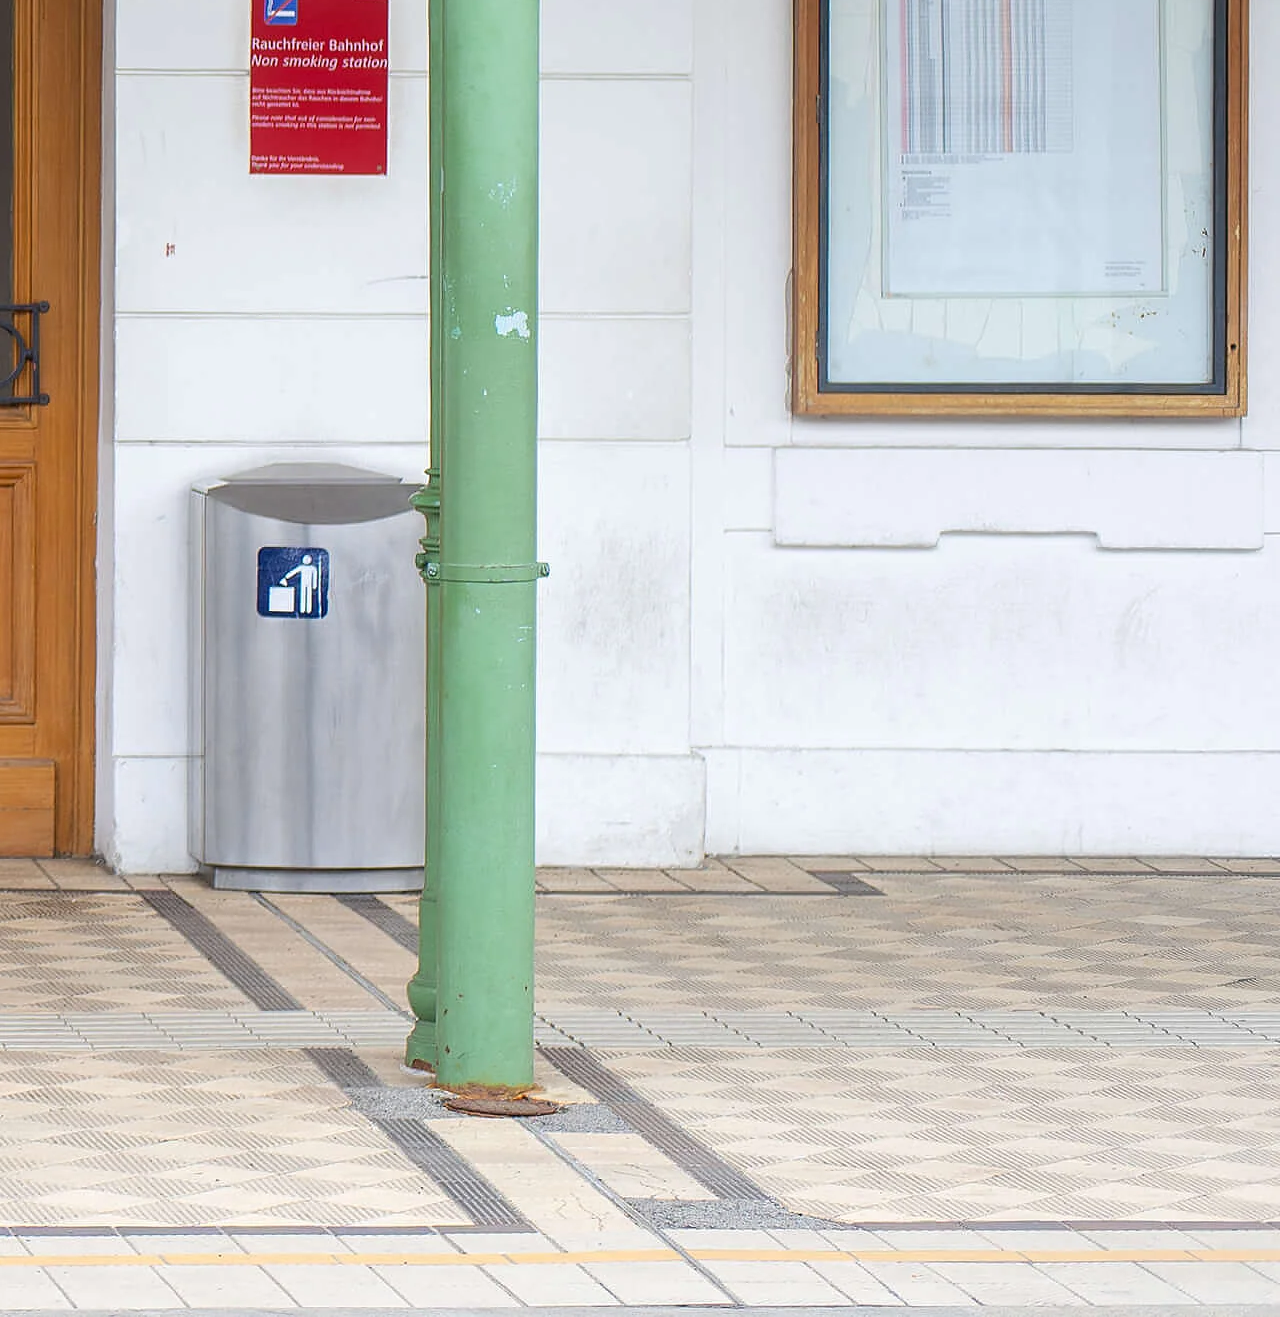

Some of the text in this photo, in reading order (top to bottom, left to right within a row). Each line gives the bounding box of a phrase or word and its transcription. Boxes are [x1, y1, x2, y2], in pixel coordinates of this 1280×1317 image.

[252, 37, 384, 52] Rauchfreier Bahnhof
[251, 54, 388, 71] Non smoking station
